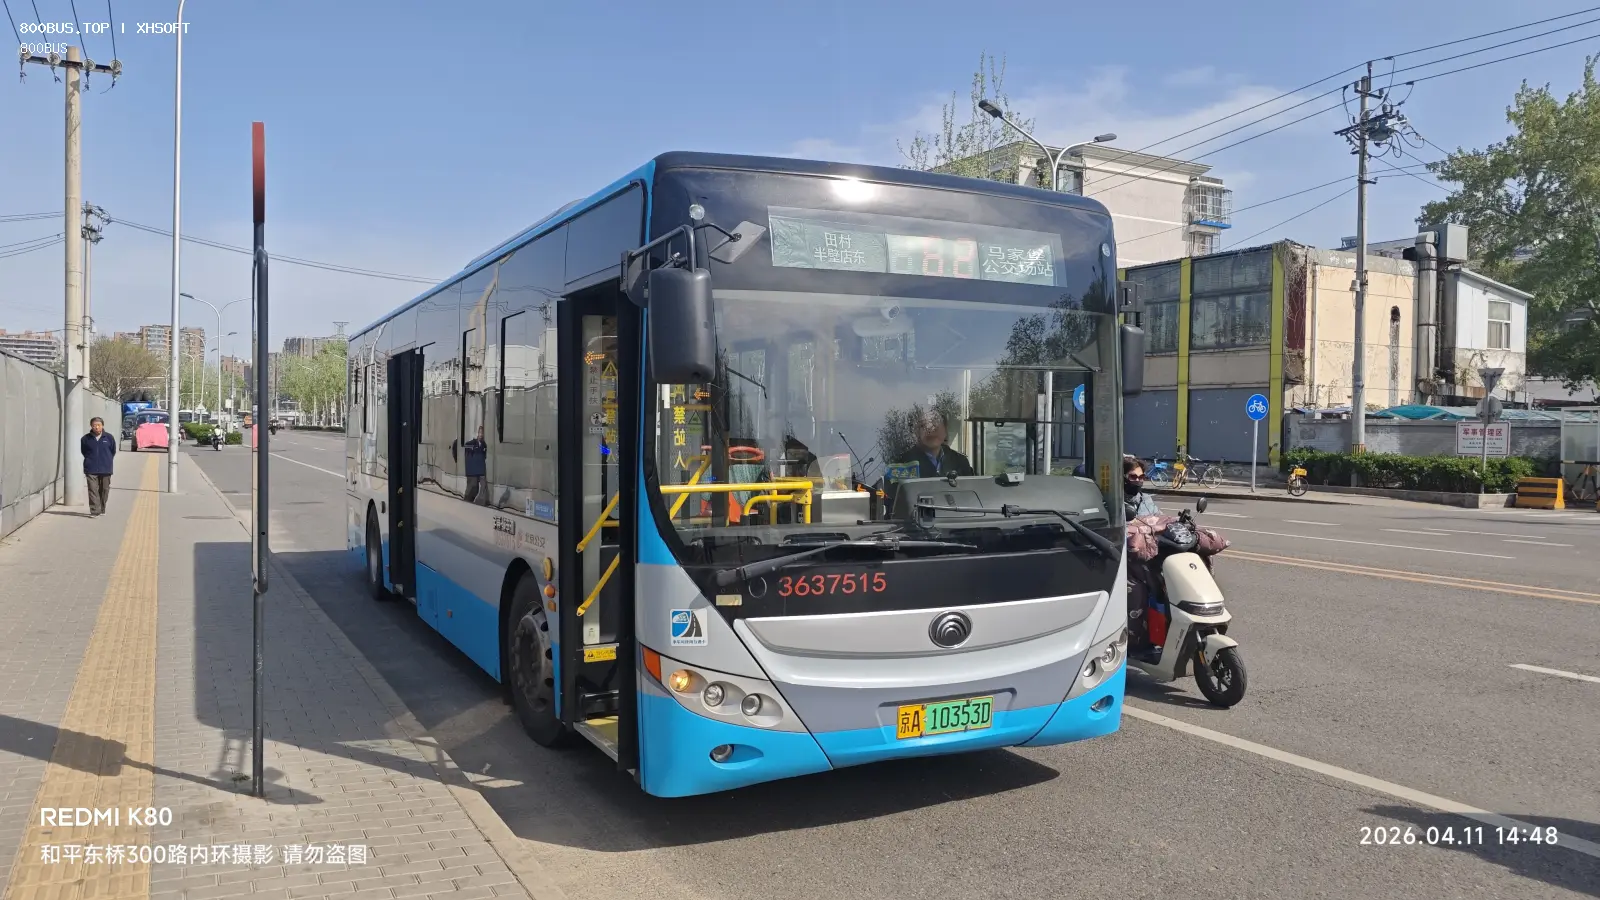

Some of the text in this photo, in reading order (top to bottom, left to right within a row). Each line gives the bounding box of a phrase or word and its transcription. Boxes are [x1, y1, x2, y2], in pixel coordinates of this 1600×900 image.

[824, 232, 851, 249] 田村
[813, 247, 866, 264] 半壁店东
[987, 246, 1047, 262] 马家堡
[982, 258, 1054, 277] 公交场站
[1462, 427, 1503, 437] 军事管理区
[777, 572, 887, 597] 3637515
[900, 702, 991, 734] 京A 10353D
